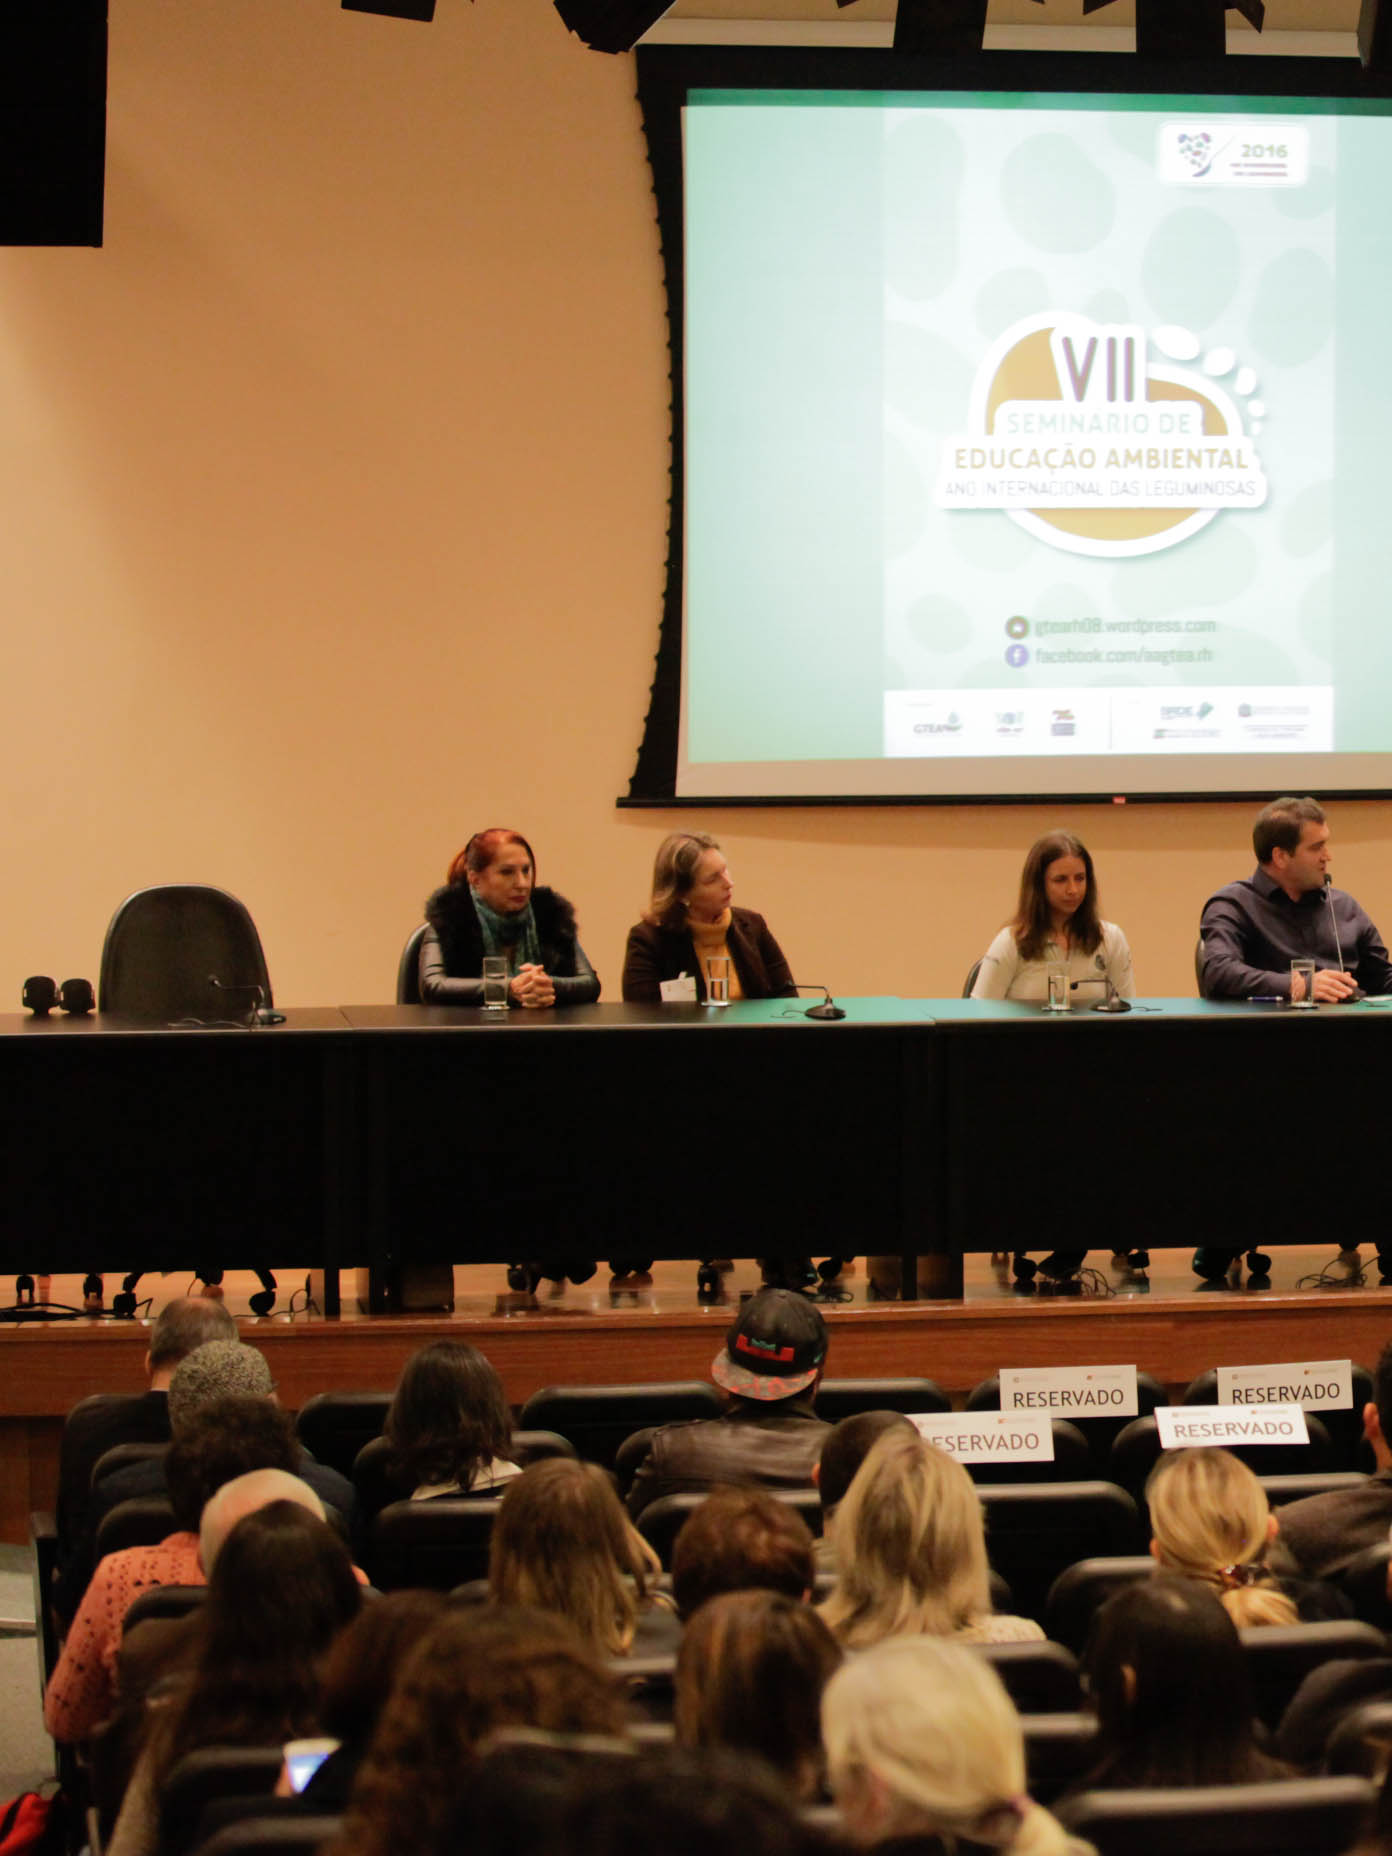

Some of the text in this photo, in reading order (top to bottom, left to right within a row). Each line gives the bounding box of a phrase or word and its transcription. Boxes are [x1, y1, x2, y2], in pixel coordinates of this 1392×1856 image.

[1241, 144, 1288, 158] 2016
[1061, 336, 1135, 403] VII
[1159, 413, 1191, 434] DE
[955, 442, 1248, 475] EDUCAÇÃO AMBIENTAL
[945, 480, 1256, 497] ANO INTERNACIONAL DAS LEGUMINOSAS
[1013, 1389, 1124, 1408] RESERVADO
[1232, 1382, 1340, 1404] RESERVADO
[1174, 1421, 1294, 1438] RESERVADO
[932, 1433, 1040, 1452] ESERVADO
